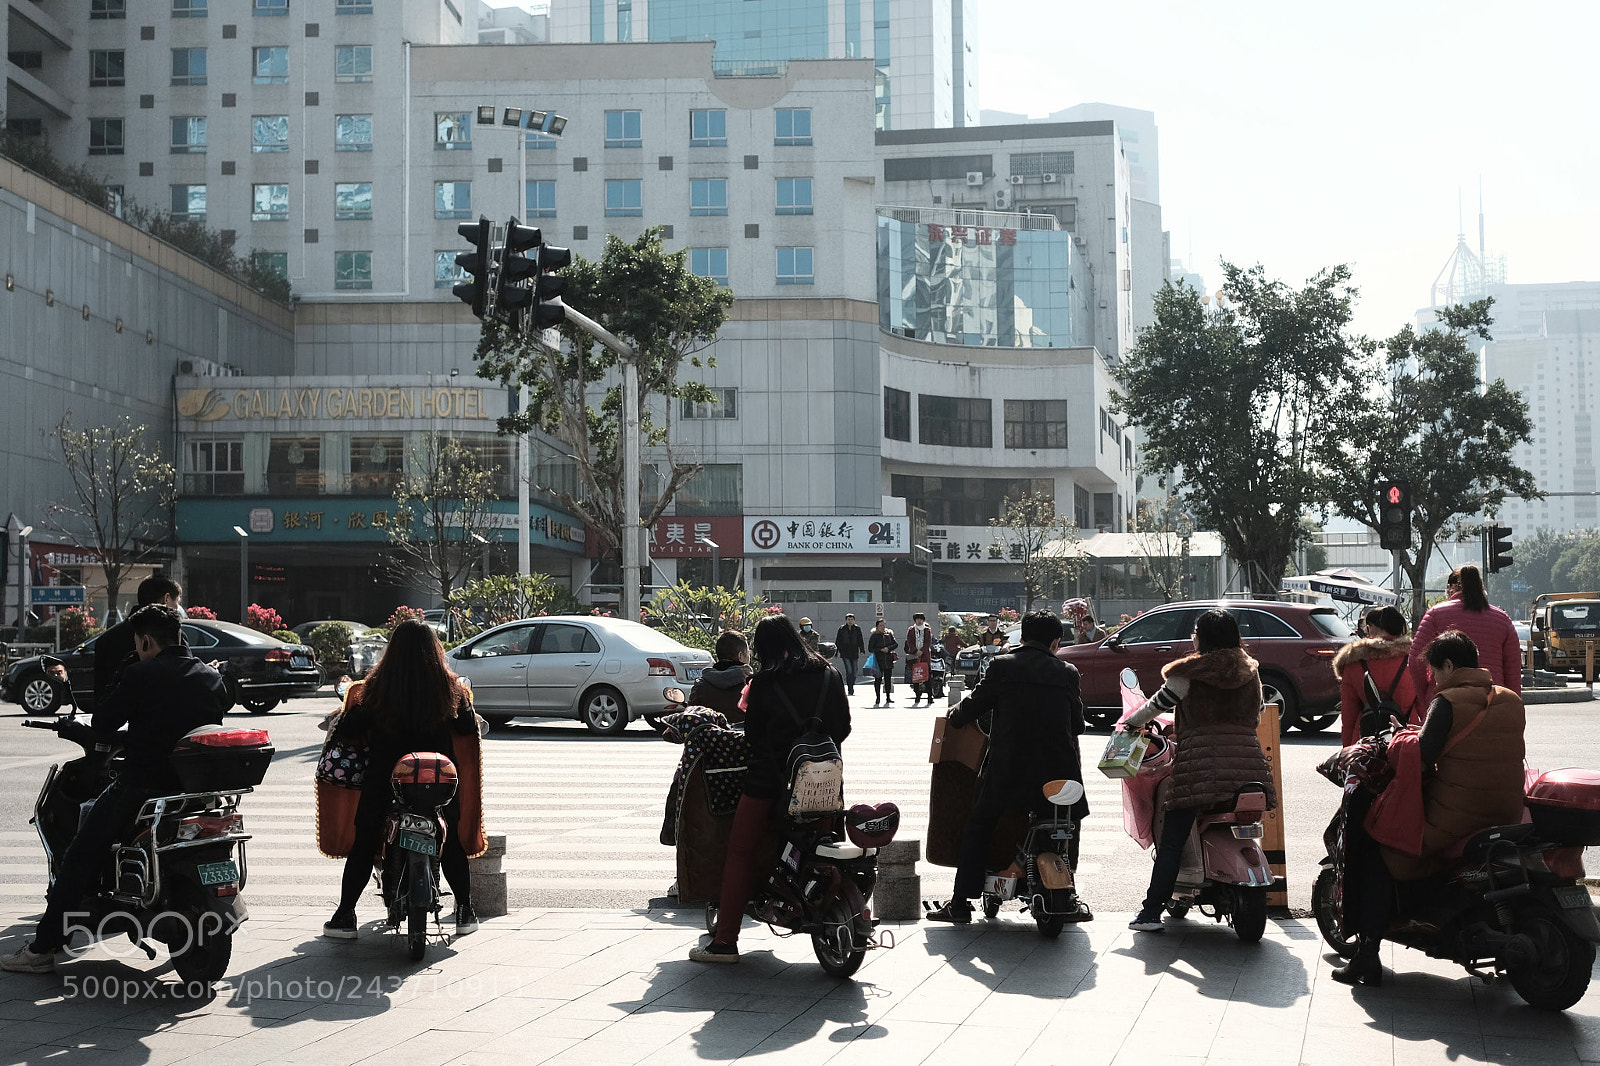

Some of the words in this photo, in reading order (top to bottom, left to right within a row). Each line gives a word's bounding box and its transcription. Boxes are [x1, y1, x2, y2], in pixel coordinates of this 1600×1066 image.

[928, 224, 1017, 246] 东兴证券
[232, 389, 321, 420] GALAXY
[326, 388, 414, 419] GARDEN
[420, 388, 489, 419] HOTEL
[787, 541, 811, 549] BANK
[812, 541, 823, 549] OF
[825, 541, 854, 549] CHINA
